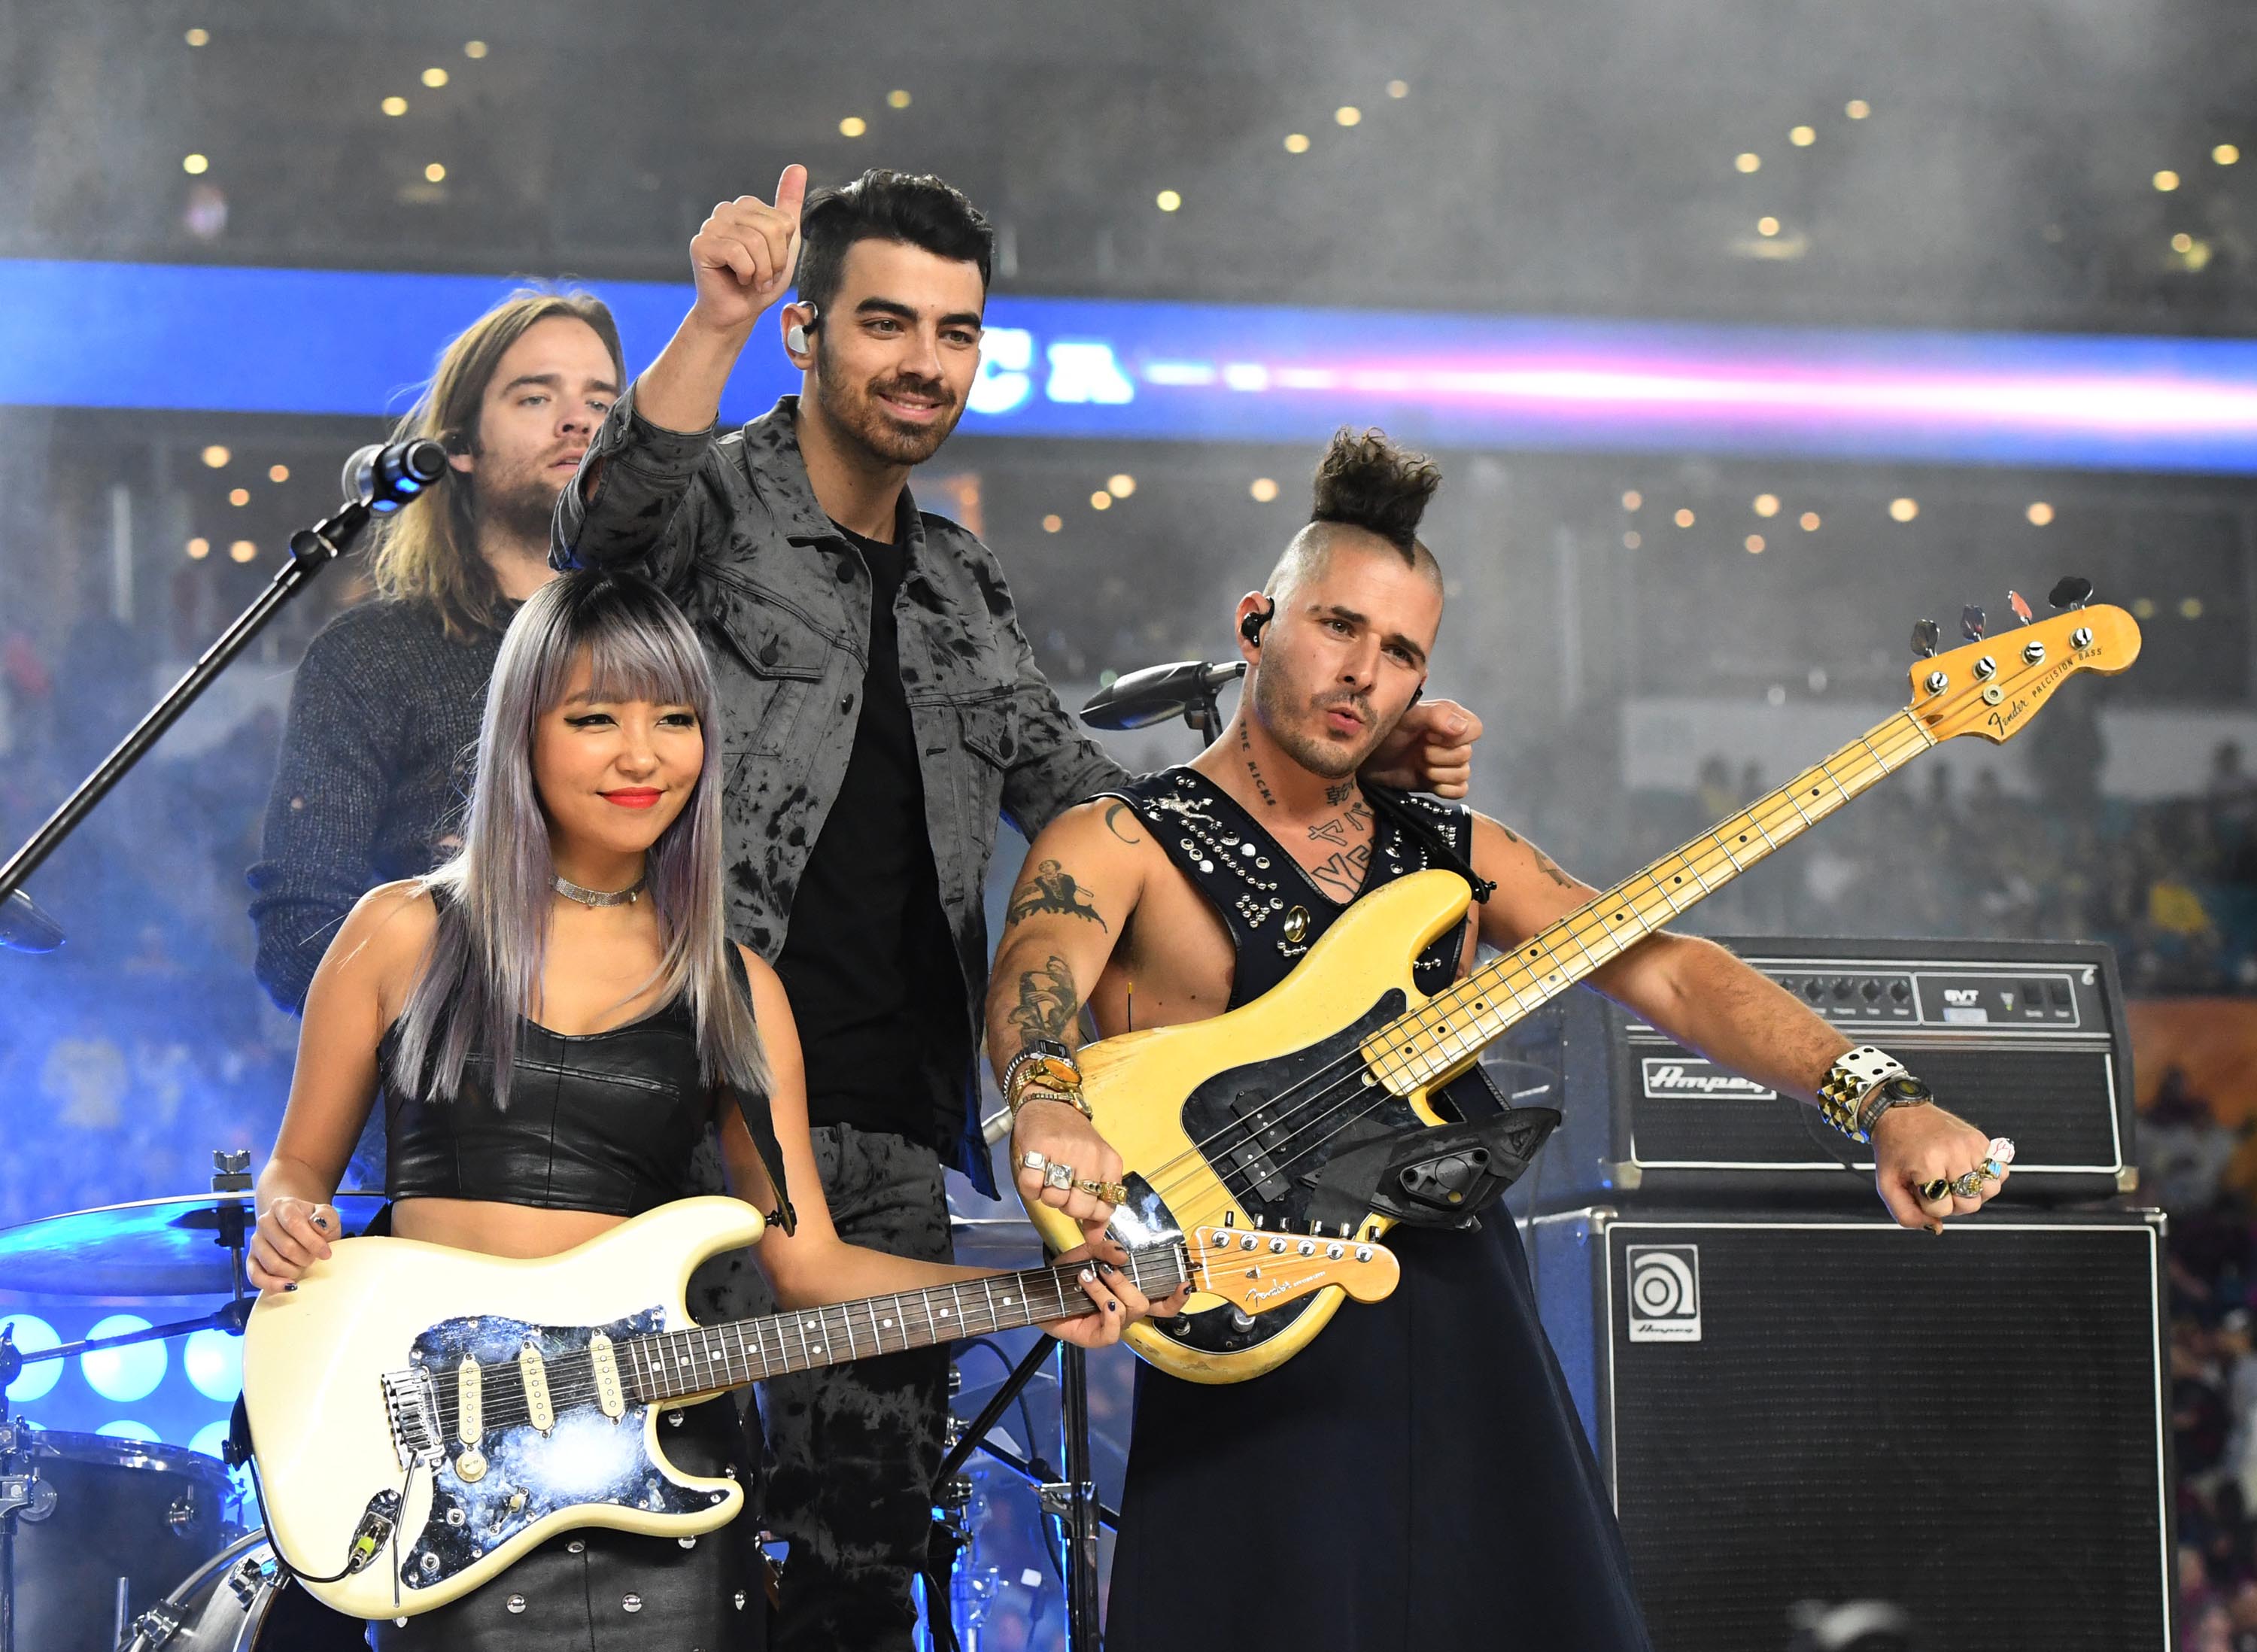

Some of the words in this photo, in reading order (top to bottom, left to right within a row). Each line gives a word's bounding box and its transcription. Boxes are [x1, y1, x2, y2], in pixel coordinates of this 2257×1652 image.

[1988, 699, 2029, 736] Fender
[2031, 657, 2073, 698] PRECISION
[2078, 647, 2103, 661] BASS
[1943, 989, 1979, 1002] SVT
